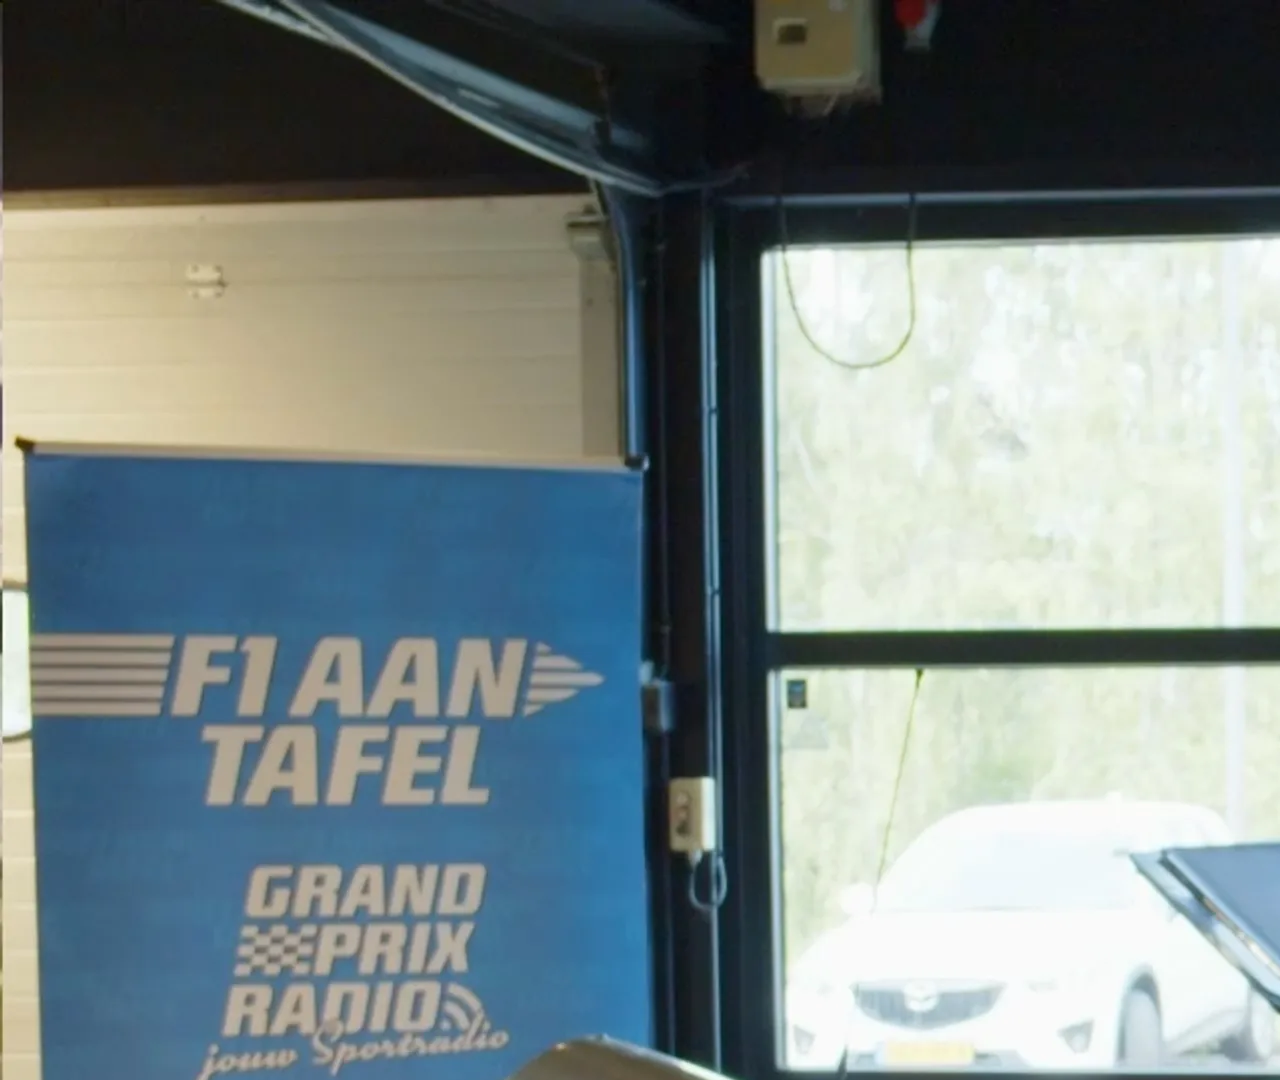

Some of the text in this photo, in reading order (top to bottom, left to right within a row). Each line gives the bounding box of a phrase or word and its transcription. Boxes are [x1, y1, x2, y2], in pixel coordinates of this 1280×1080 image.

[171, 636, 528, 718] F1 AAN
[202, 725, 490, 806] TAFEL
[245, 864, 487, 918] GRAND
[312, 922, 474, 975] PRIX
[222, 980, 442, 1037] RADIO
[312, 1008, 509, 1077] Sportradio
